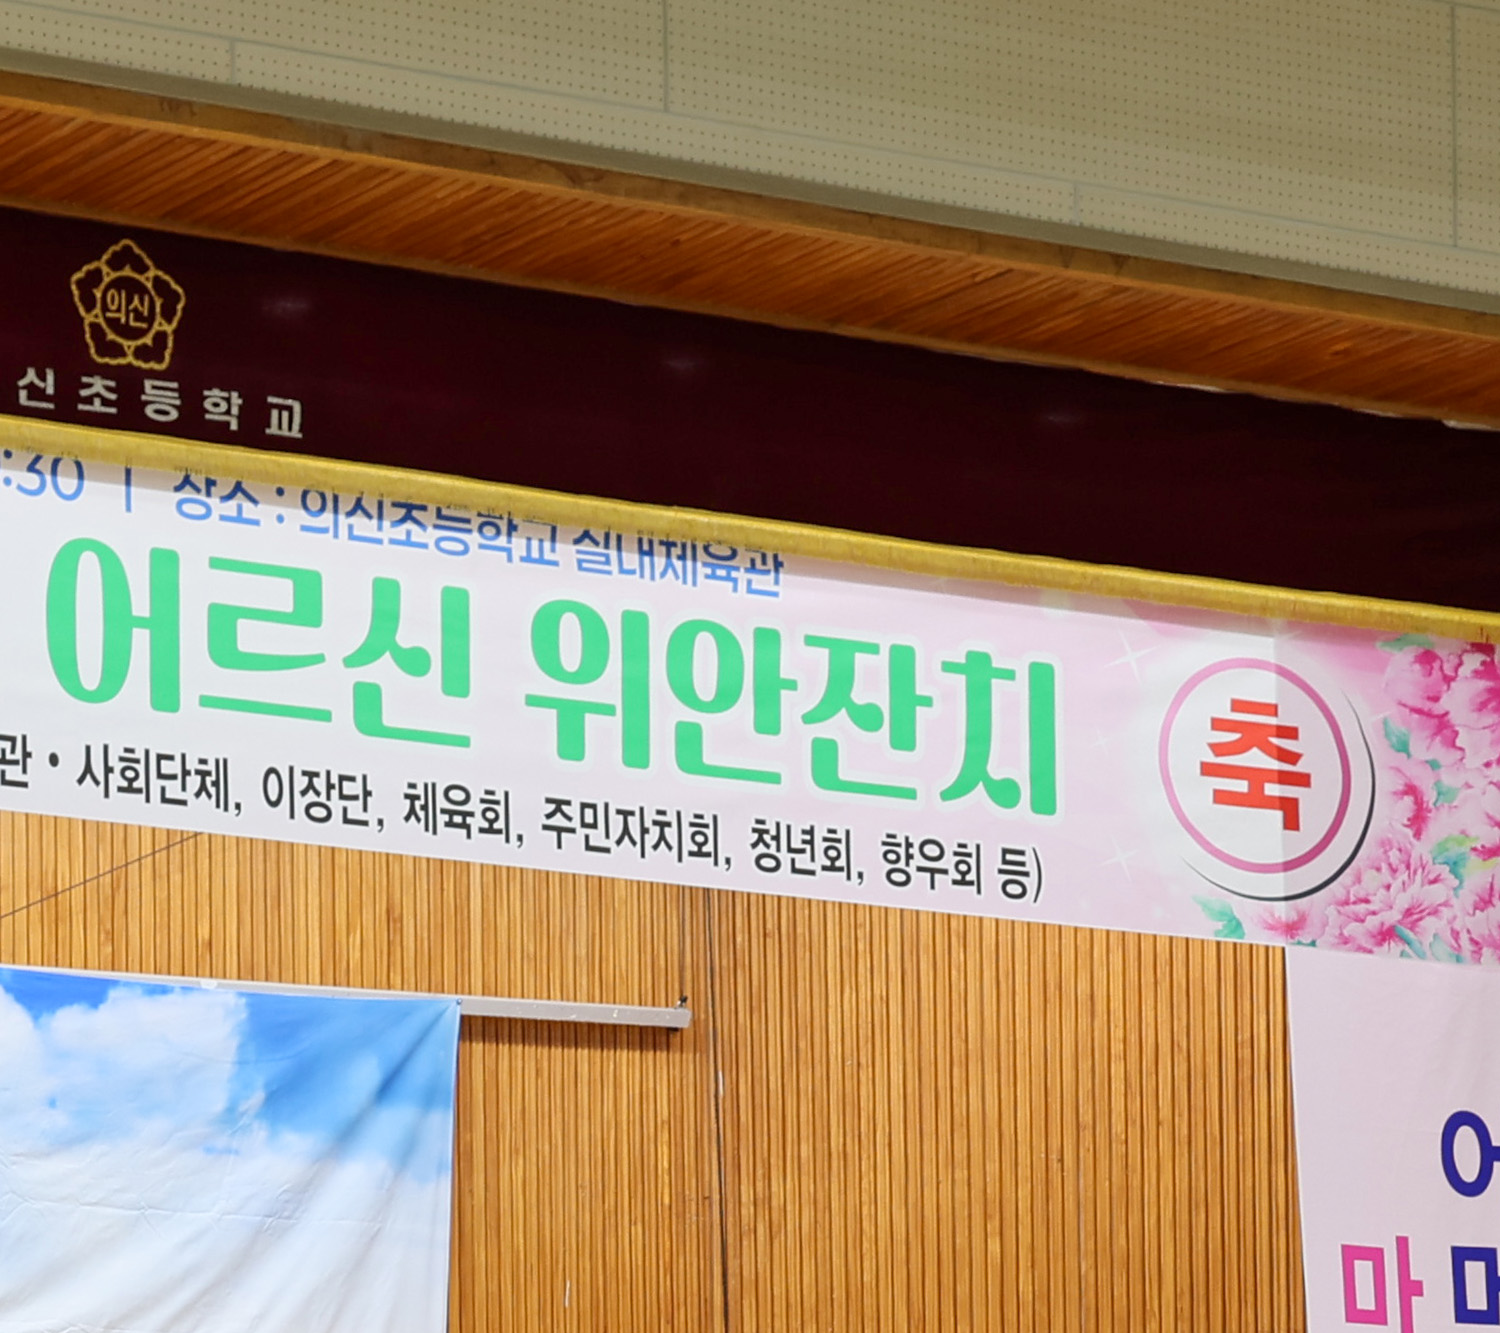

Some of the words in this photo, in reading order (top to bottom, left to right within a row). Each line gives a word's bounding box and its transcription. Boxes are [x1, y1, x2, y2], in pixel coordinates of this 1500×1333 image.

[106, 287, 151, 327] 의신
[45, 536, 473, 750] 어르신
[523, 597, 1060, 818] 위안잔치
[75, 750, 243, 819] 사회단체,
[262, 764, 386, 833] 이장단,
[401, 778, 526, 851] 체육회,
[540, 796, 734, 873] 주민자치회,
[748, 820, 866, 888] 청년회,
[879, 830, 984, 897] 향우회
[996, 844, 1045, 904] 등)
[1199, 696, 1313, 833] 축
